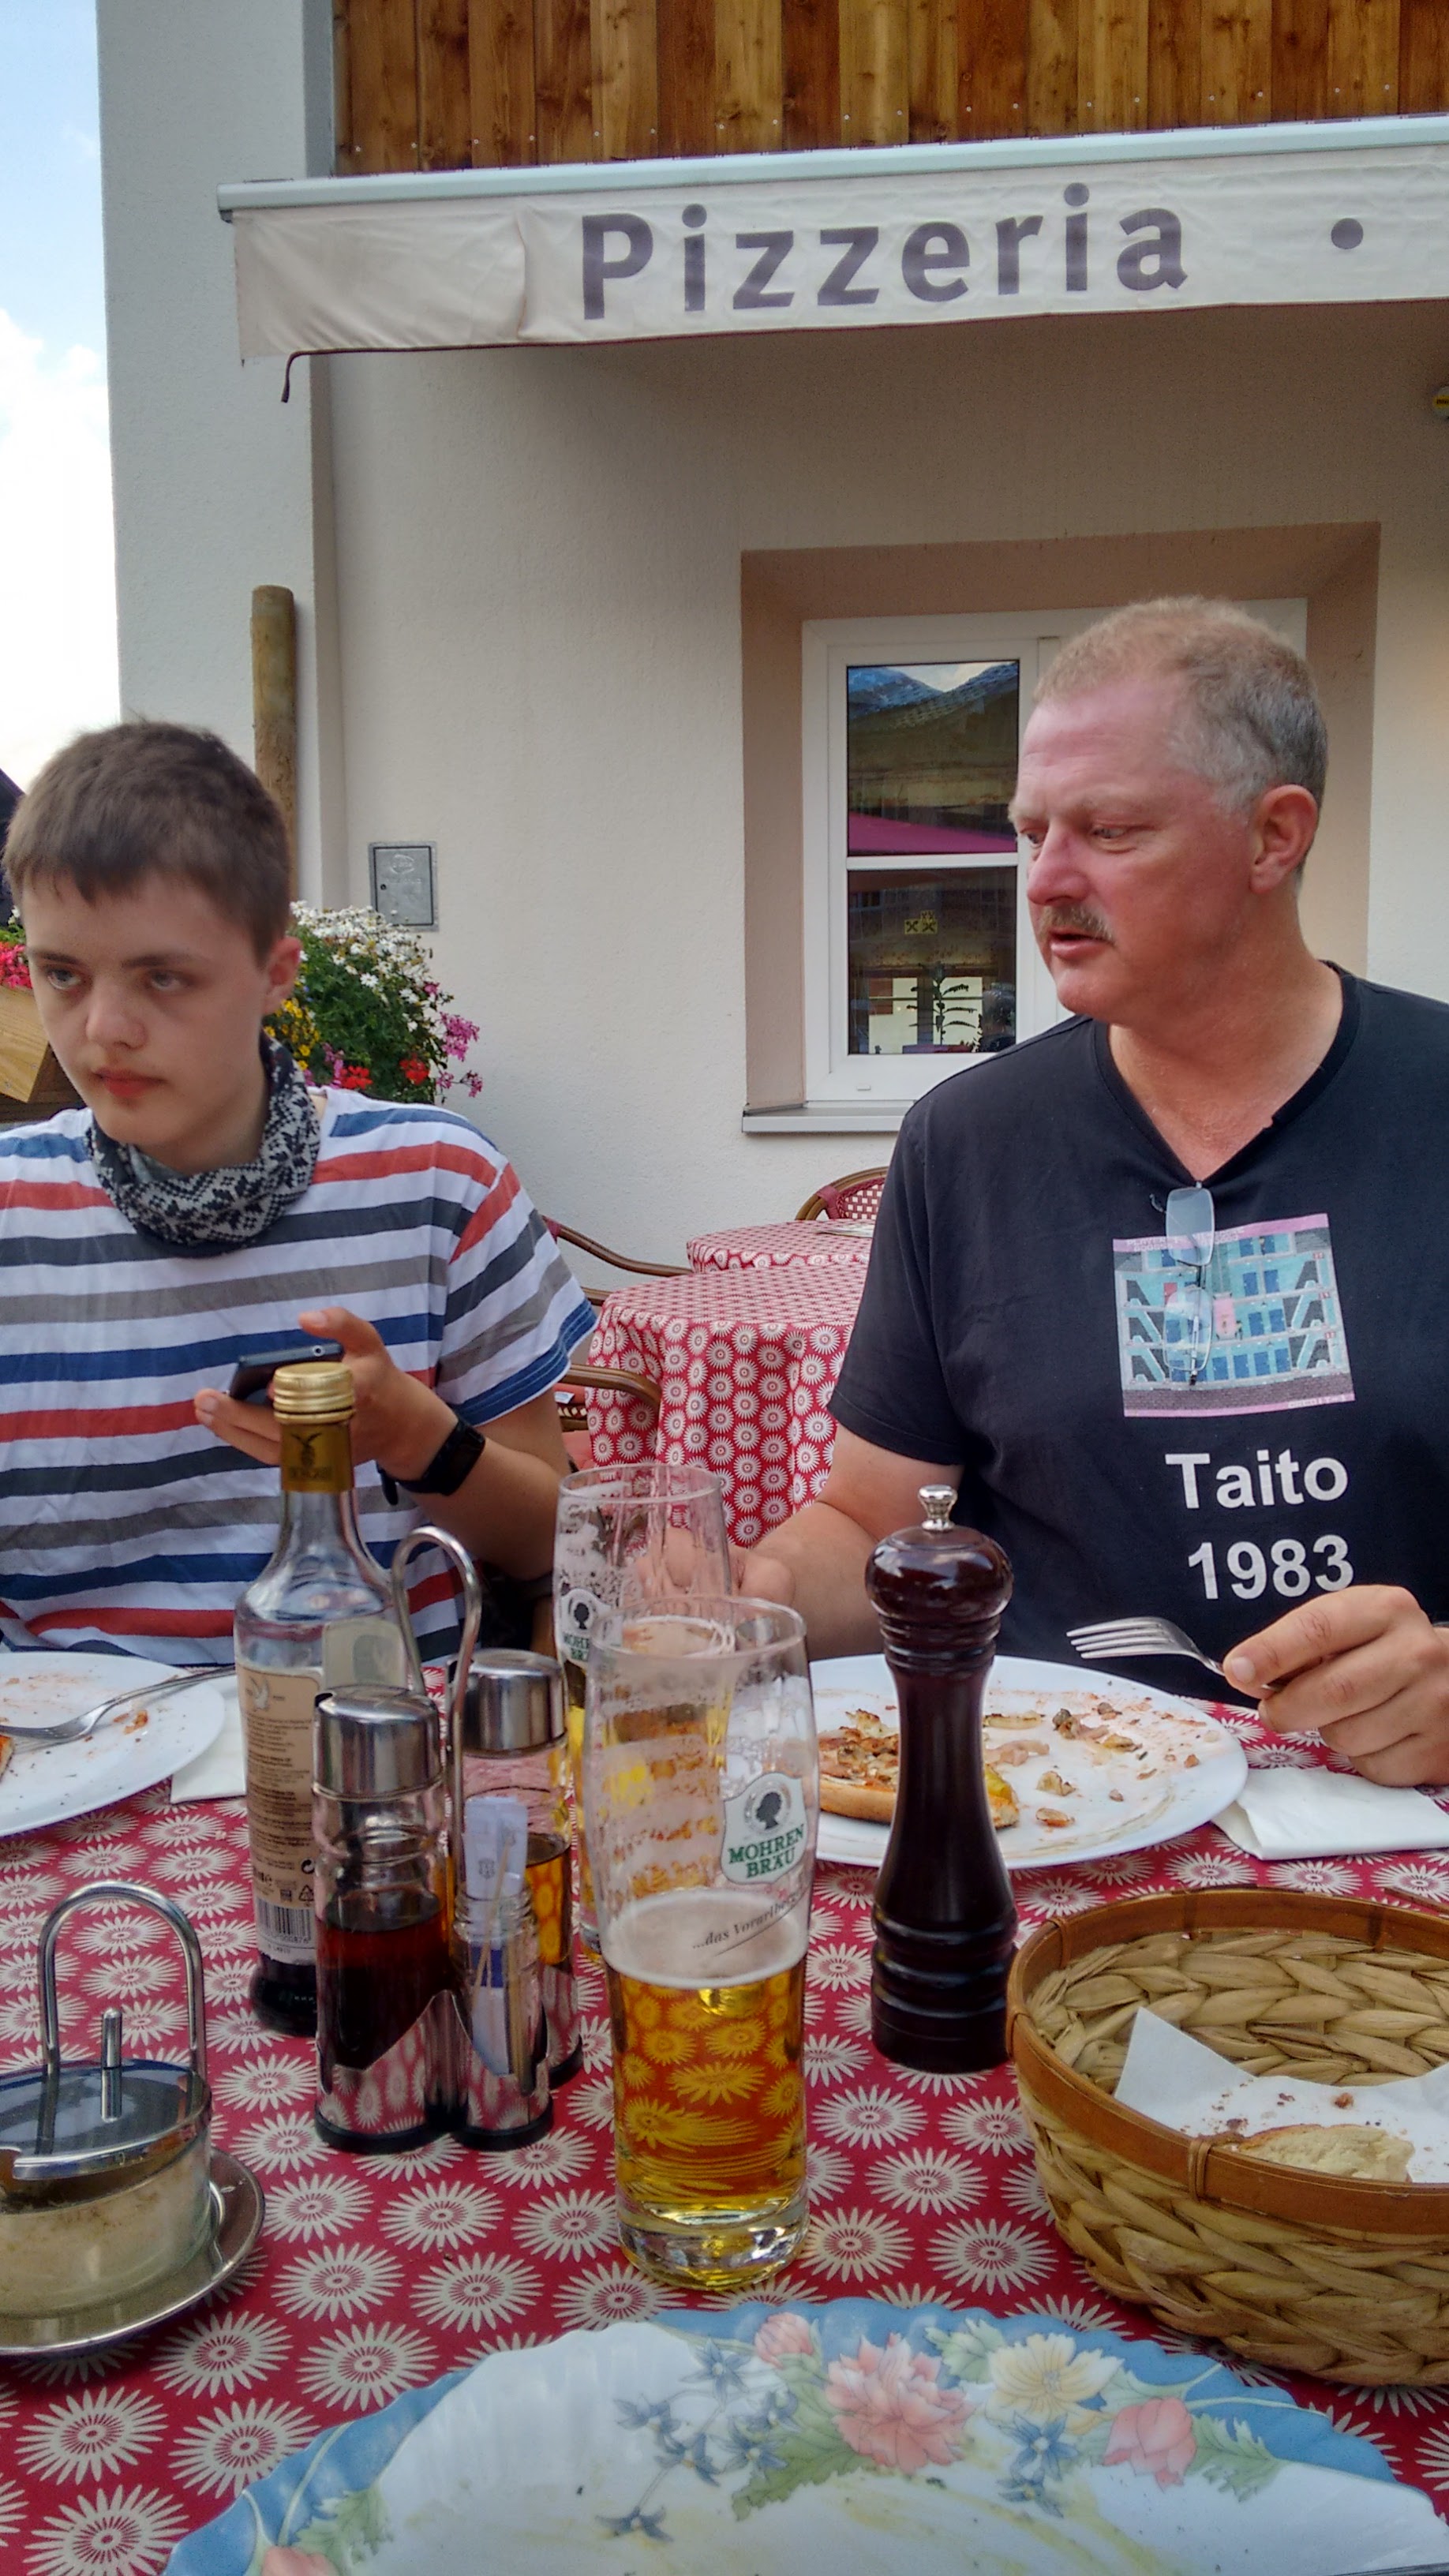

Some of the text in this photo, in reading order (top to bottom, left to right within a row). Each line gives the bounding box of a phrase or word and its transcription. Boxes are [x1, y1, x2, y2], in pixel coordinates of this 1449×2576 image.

[582, 182, 1188, 320] Pizzeria
[1165, 1449, 1348, 1509] Taito
[1188, 1534, 1354, 1600] 1983
[728, 1824, 804, 1864] MOHREN
